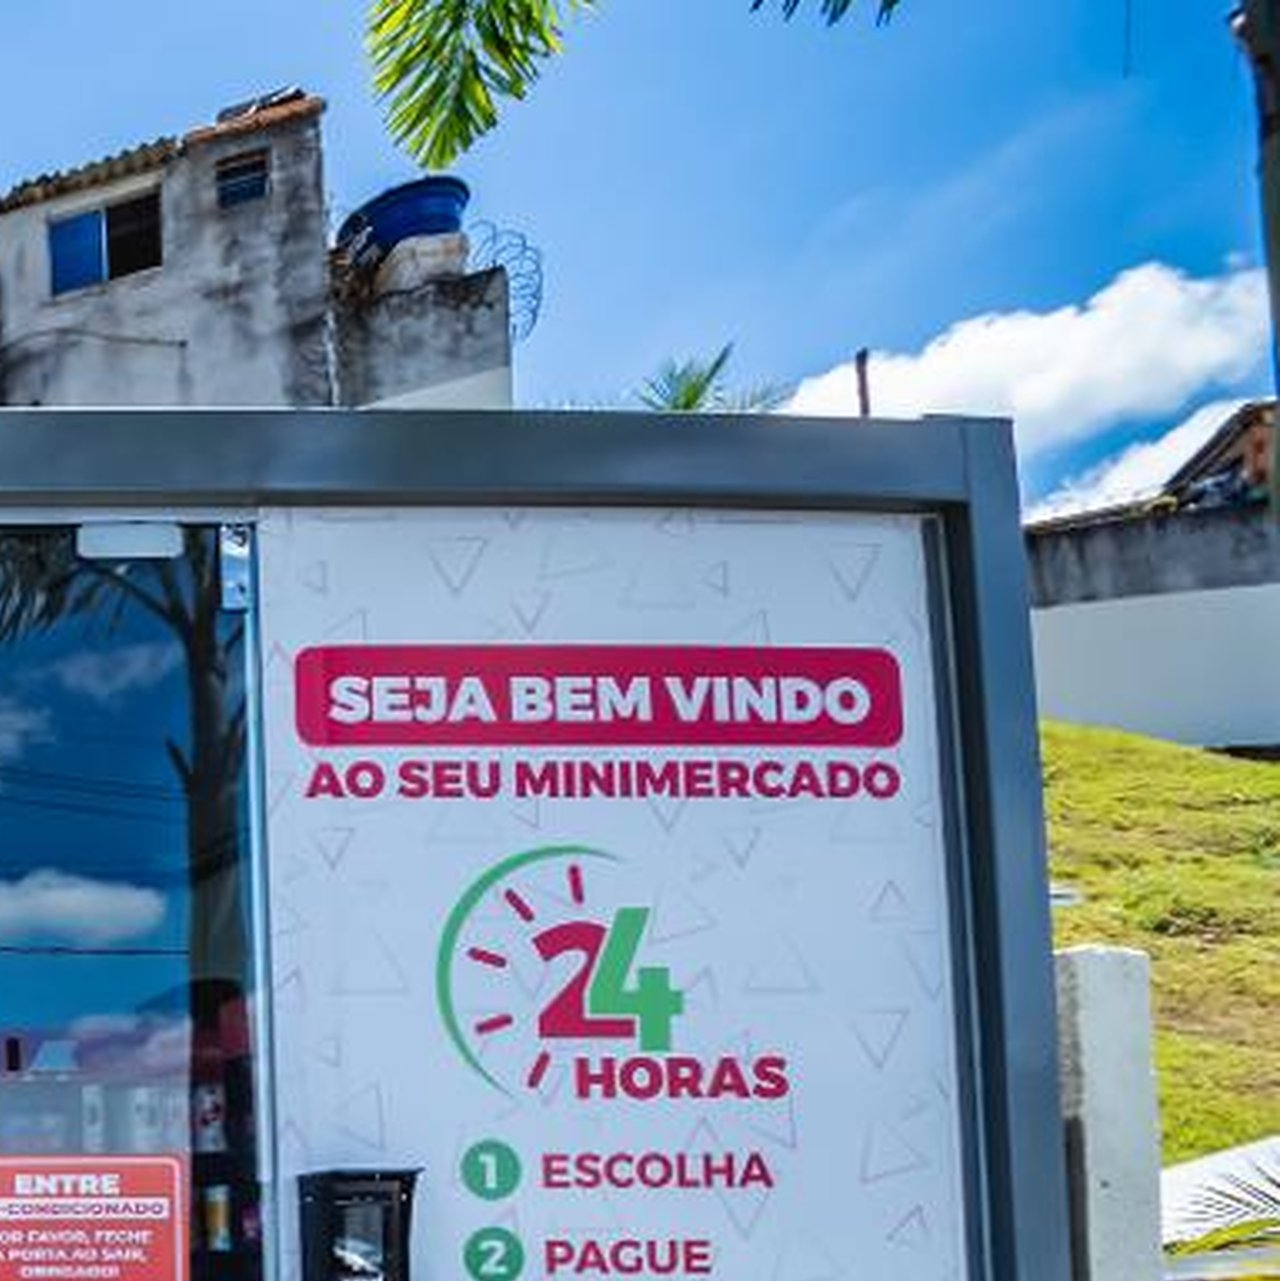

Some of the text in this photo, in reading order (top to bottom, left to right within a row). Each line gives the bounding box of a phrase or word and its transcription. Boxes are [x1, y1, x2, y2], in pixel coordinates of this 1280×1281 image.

[328, 676, 871, 724] SEJA BEM VINDO
[306, 761, 900, 799] AO SEU MINIMERCADO
[533, 906, 684, 1051] 24
[576, 1057, 790, 1100] HORAS
[14, 1173, 121, 1195] ENTRE
[478, 1152, 773, 1188] 1 ESCOLHA
[8, 1249, 69, 1261] PORTA
[71, 1249, 98, 1261] AO
[94, 1230, 153, 1244] FECHE
[480, 1239, 712, 1274] 2 PAGUE
